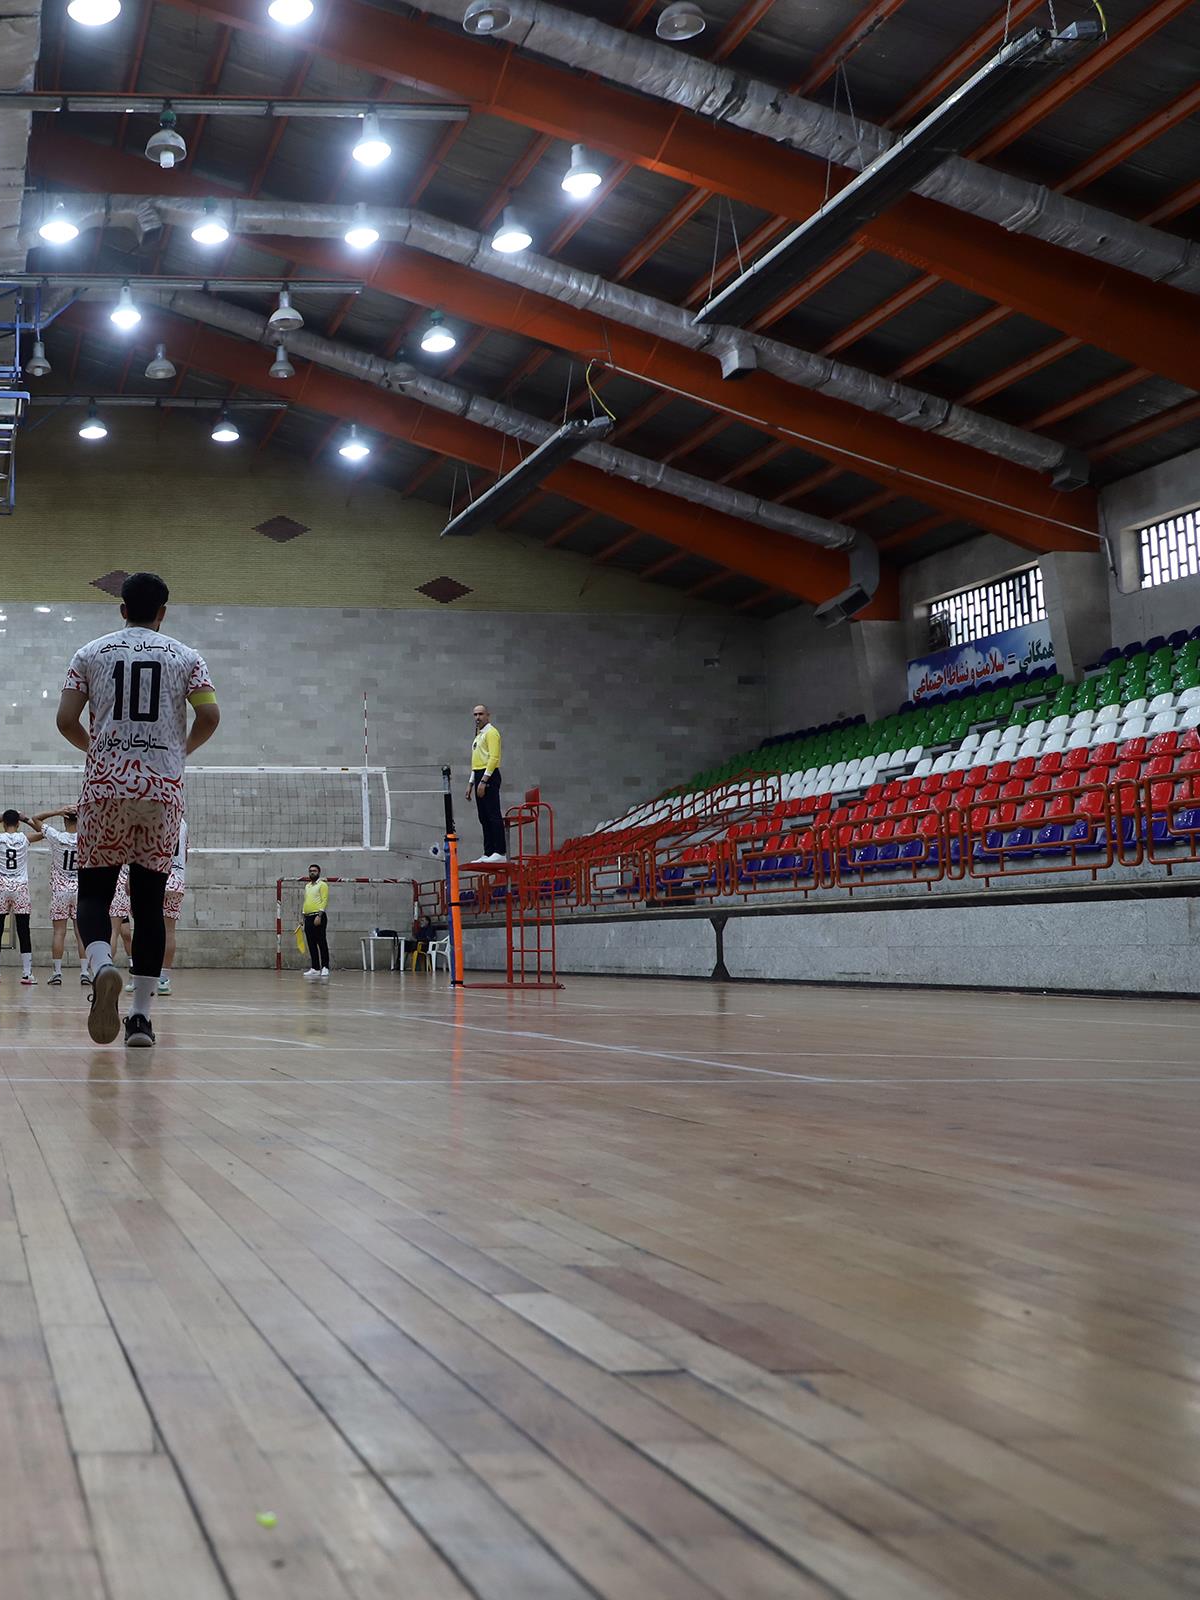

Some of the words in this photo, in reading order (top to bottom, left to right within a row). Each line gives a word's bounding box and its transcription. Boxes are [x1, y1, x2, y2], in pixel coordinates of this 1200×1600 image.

[100, 640, 130, 654] شیمی
[133, 641, 176, 658] پارسیان
[947, 660, 969, 686] نشاط
[975, 651, 1005, 678] سلامت
[112, 660, 161, 722] 10
[912, 664, 947, 700] اجتماعی
[6, 849, 17, 870] 8
